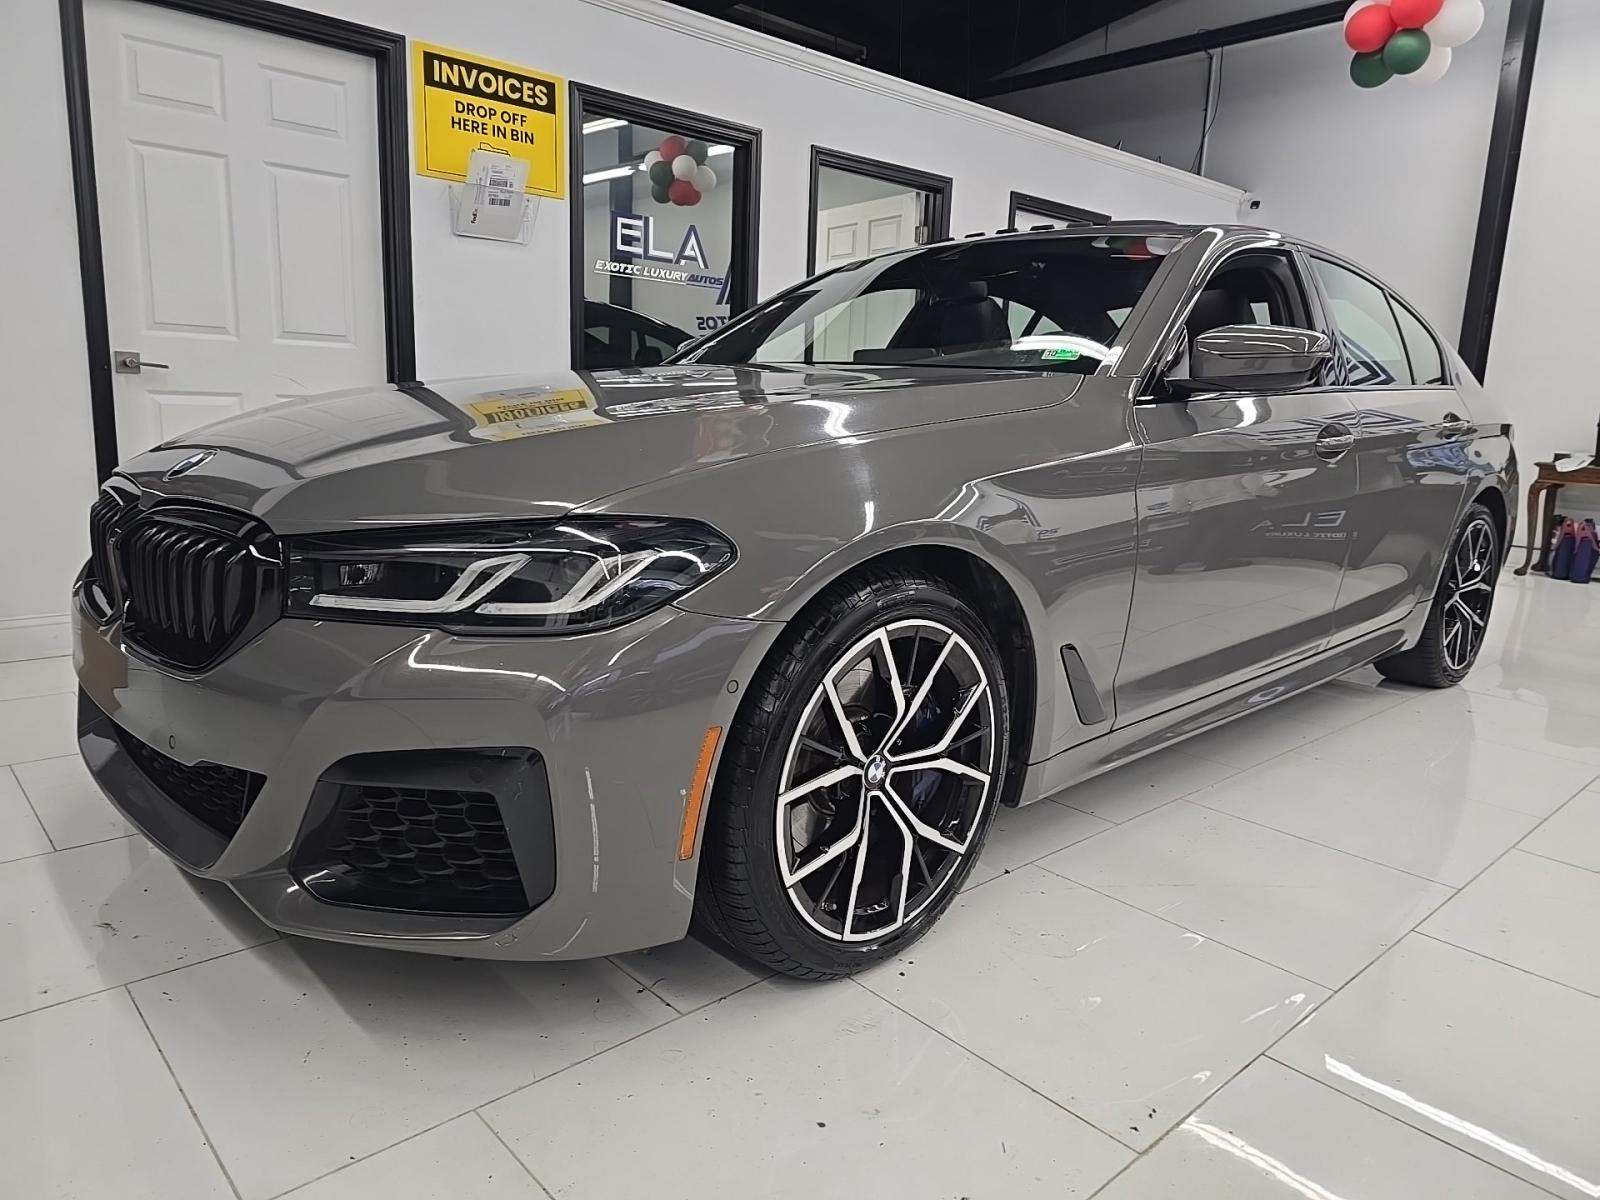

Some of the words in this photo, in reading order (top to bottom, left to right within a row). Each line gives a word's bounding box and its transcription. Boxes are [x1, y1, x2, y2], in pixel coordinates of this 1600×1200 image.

[433, 60, 548, 106] INVOICES
[455, 100, 497, 120] DROP
[500, 111, 527, 127] OFF
[451, 116, 488, 136] HERE
[492, 124, 507, 139] IN
[510, 128, 535, 145] BIN
[610, 211, 709, 270] ELA
[594, 259, 642, 275] EXOTIC
[643, 266, 688, 282] LUXURY
[687, 273, 724, 286] AUTOS
